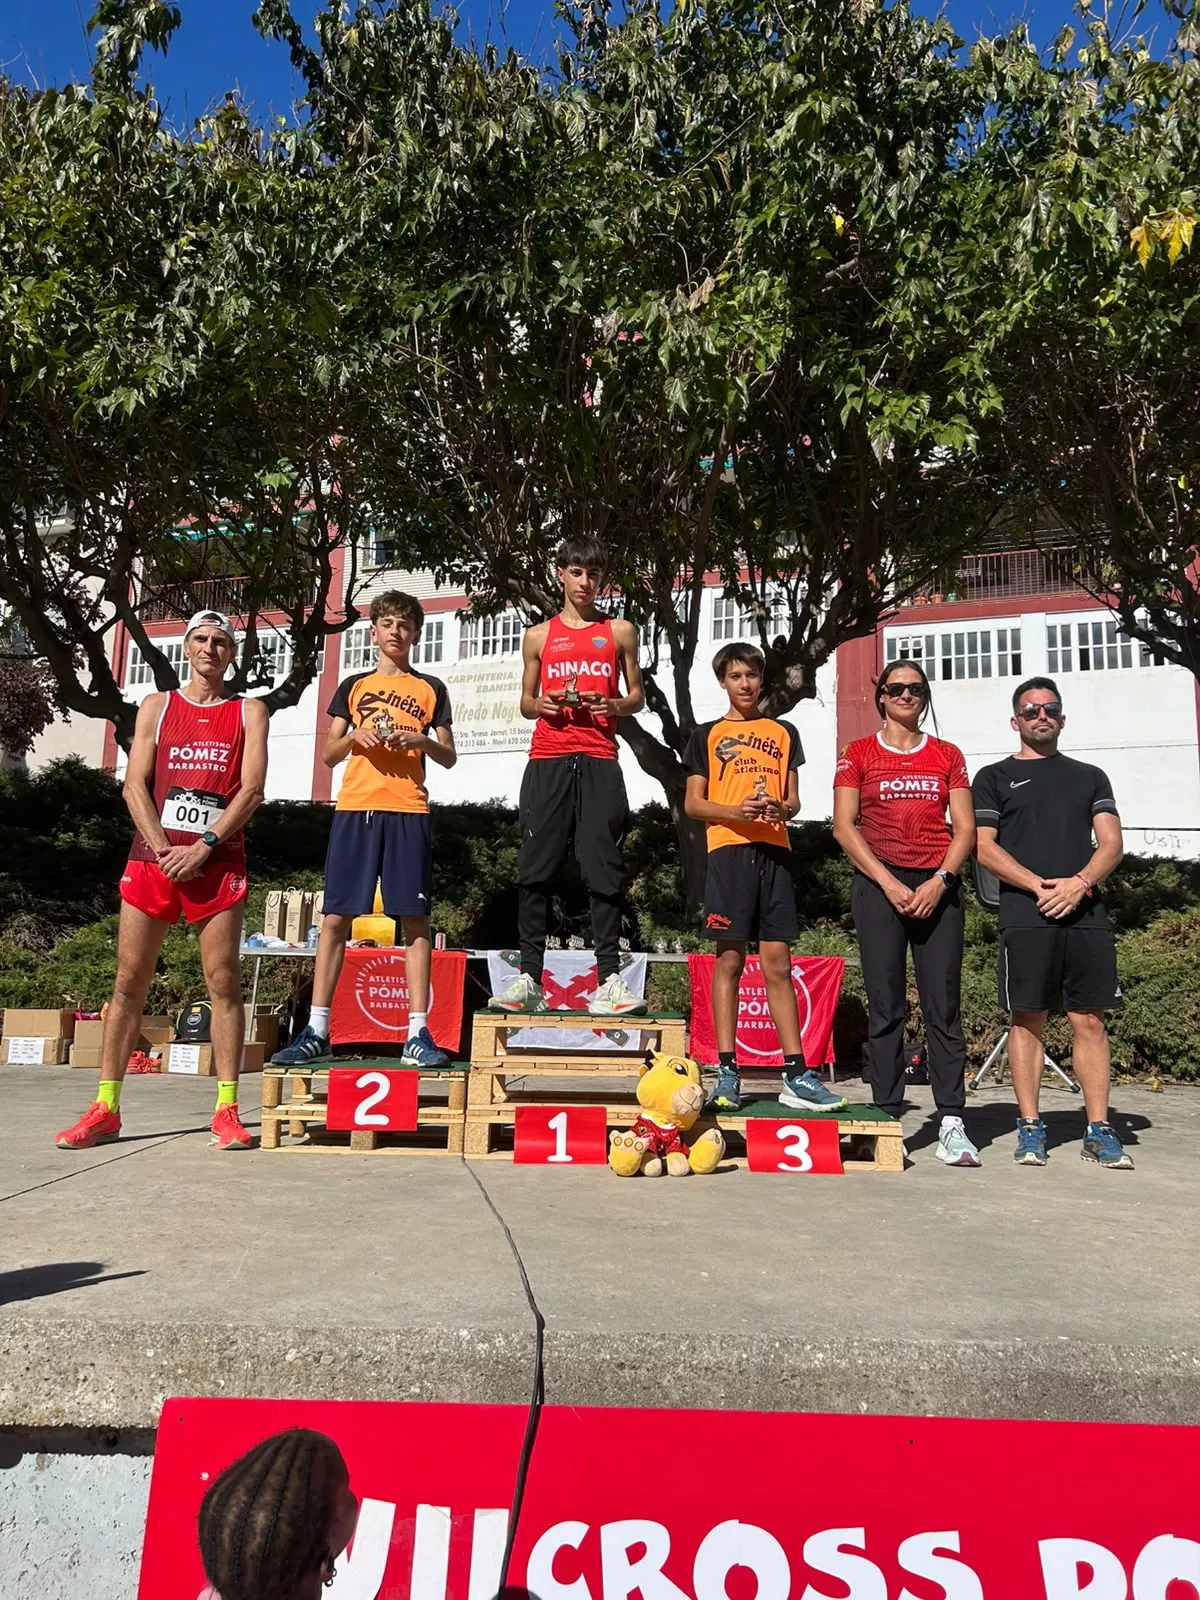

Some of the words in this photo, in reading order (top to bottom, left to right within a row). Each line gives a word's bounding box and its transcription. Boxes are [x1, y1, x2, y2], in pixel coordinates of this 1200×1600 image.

[547, 660, 612, 679] HINACO
[447, 671, 514, 684] CARPINTERIA
[453, 701, 488, 722] lfredo
[192, 741, 231, 749] ATLETISMO
[465, 740, 475, 748] 313
[169, 744, 229, 763] PÓMEZ
[168, 762, 227, 772] BARBASTRO
[734, 757, 757, 766] club
[734, 765, 779, 775] atletismo
[879, 778, 940, 792] PÓMEZ
[176, 806, 209, 826] 001
[368, 975, 408, 984] ATLETIS
[368, 984, 409, 999] PÓM
[354, 1071, 391, 1126] 2
[546, 1111, 574, 1163] 1
[775, 1124, 814, 1172] 3
[526, 1518, 985, 1600] CROSS
